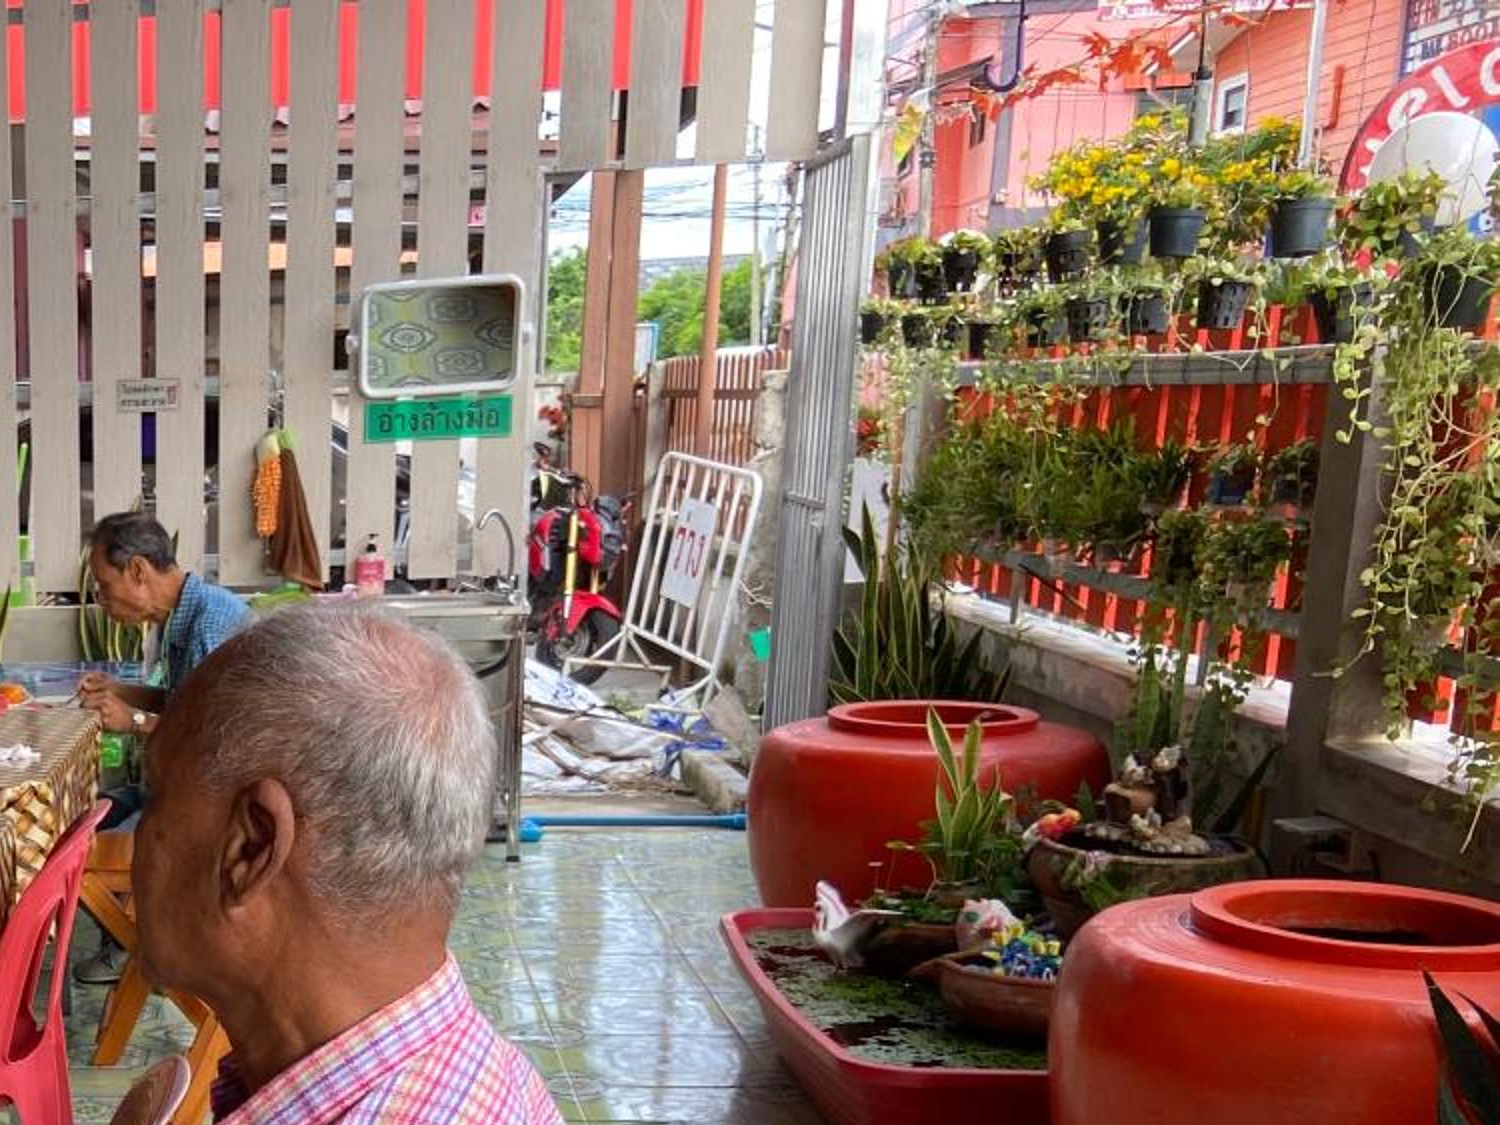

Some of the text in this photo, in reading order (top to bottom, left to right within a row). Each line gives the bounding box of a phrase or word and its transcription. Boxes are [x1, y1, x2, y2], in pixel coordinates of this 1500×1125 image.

[378, 401, 500, 433] อ่างล้างมือ
